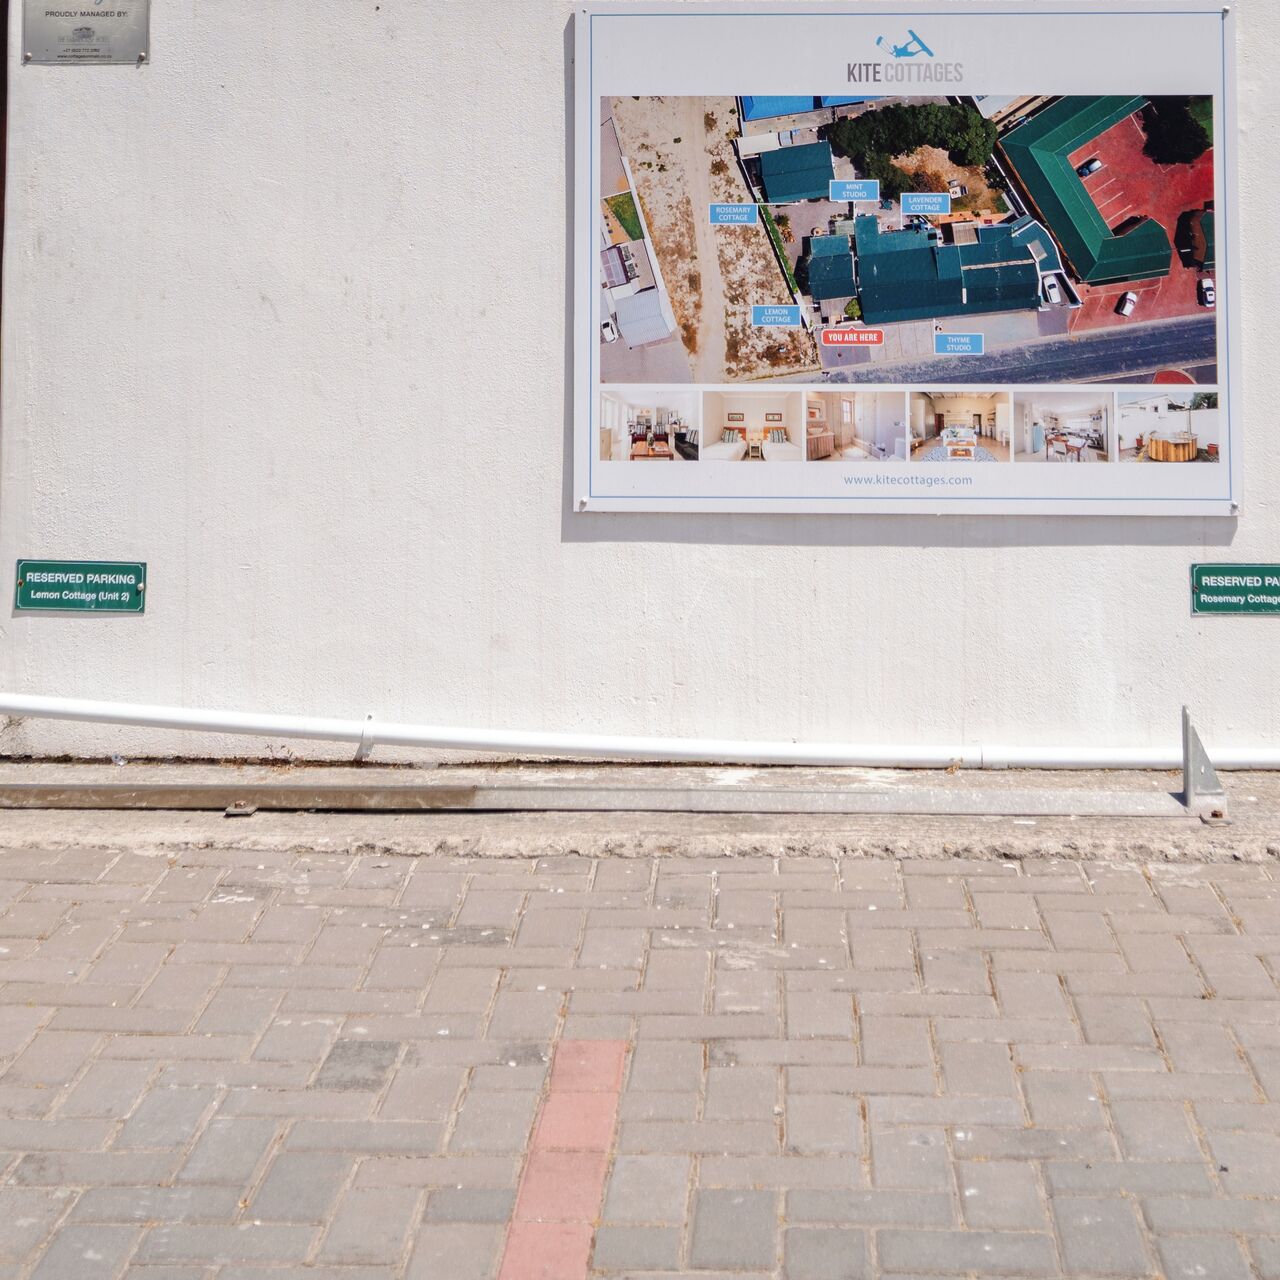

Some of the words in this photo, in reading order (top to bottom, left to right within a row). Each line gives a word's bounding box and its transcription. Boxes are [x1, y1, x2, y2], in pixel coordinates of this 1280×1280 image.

[847, 63, 881, 83] KITE
[884, 63, 964, 83] COTTAGES
[828, 333, 843, 341] YOU
[844, 333, 858, 342] ARE
[859, 333, 878, 342] HERE
[844, 474, 973, 487] www.kitecottages.com
[26, 572, 84, 584] RESERVED
[86, 573, 136, 585] PARKING
[1201, 576, 1262, 587] RESERVED
[30, 590, 60, 599] Lemon
[62, 591, 97, 602] Cottage
[98, 591, 119, 602] (Unit
[121, 592, 129, 602] 2)
[1200, 594, 1245, 605] Rosemary
